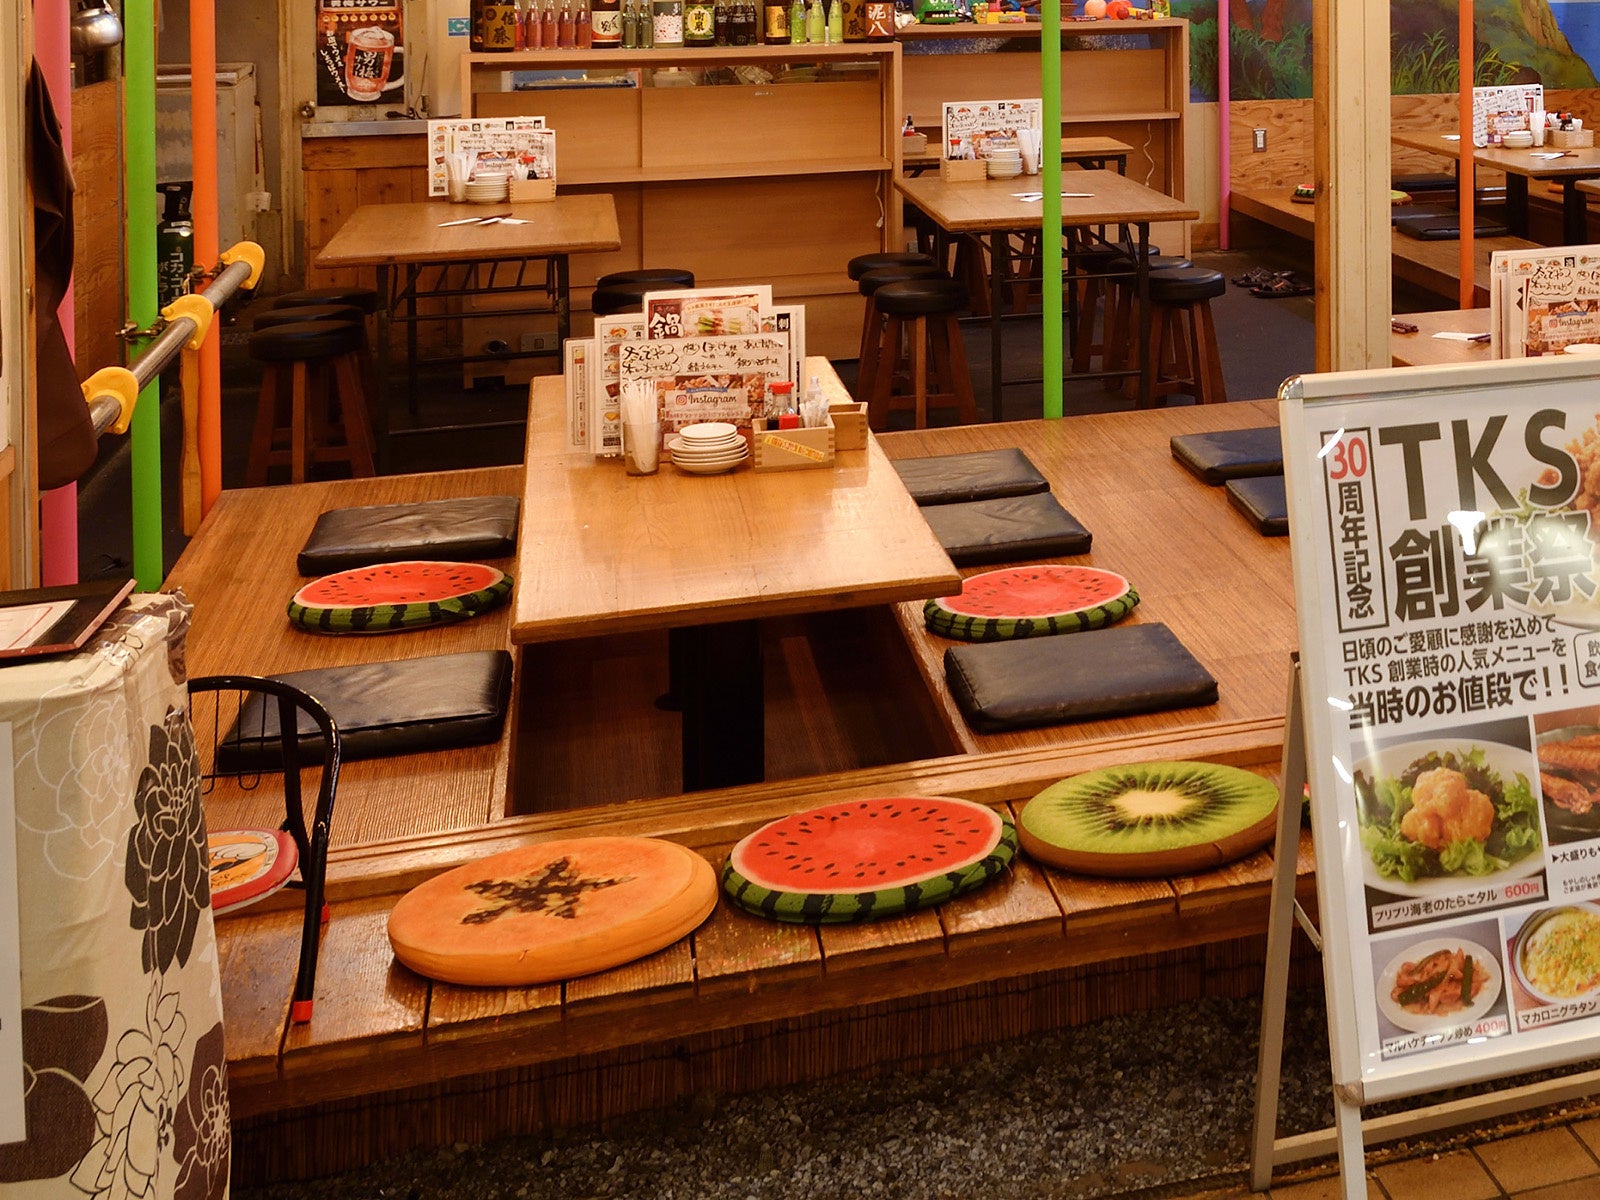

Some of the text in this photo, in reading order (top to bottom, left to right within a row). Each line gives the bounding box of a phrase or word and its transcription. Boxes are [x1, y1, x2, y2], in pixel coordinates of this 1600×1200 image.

[867, 3, 890, 37] 泥八
[1559, 317, 1594, 328] Instagram
[688, 394, 737, 407] Instagram
[1378, 408, 1579, 522] TKS
[1389, 510, 1599, 623] 創業祭
[1342, 613, 1557, 663] 日頃のご愛顧に感謝を込めて
[1344, 636, 1567, 687] TKS 創業時の人気メニューを
[1347, 662, 1570, 730] 当時のお値段で!!
[1375, 882, 1540, 923] プリプリ海老のたらこタル 600円
[1474, 1021, 1507, 1035] 400円
[1521, 1000, 1597, 1026] マカロニグラタン
